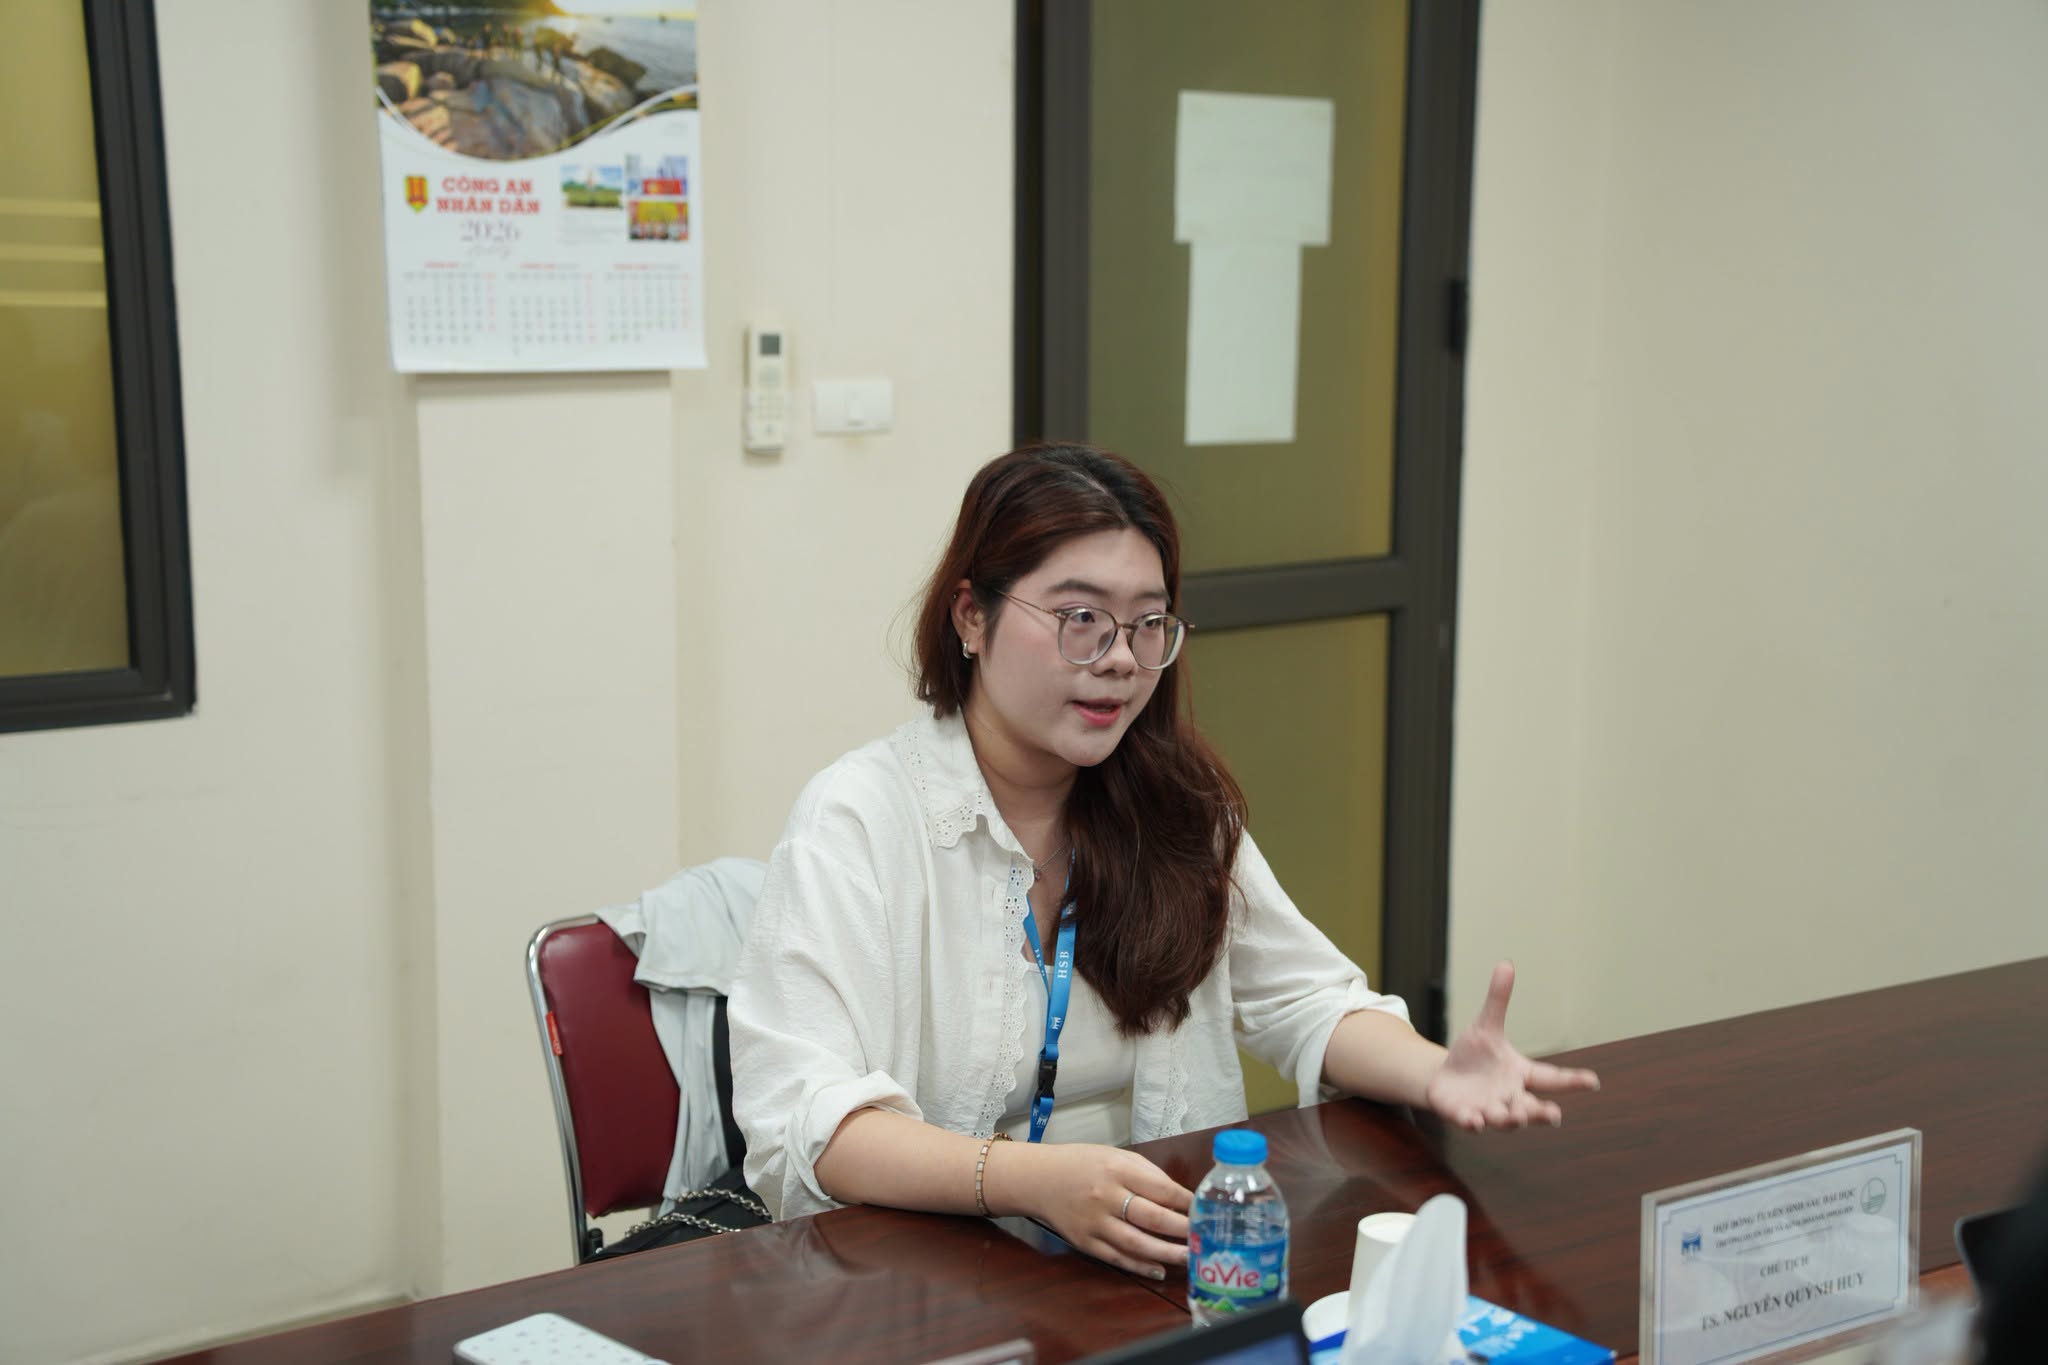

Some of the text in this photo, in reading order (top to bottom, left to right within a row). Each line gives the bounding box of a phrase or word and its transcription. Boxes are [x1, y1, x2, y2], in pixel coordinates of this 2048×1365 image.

[442, 174, 533, 194] CÔNG AN
[436, 196, 541, 214] NHÂN DÂN
[1057, 951, 1070, 979] HSB
[1784, 1255, 1809, 1272] TỊCH
[1837, 1271, 1865, 1292] HUY
